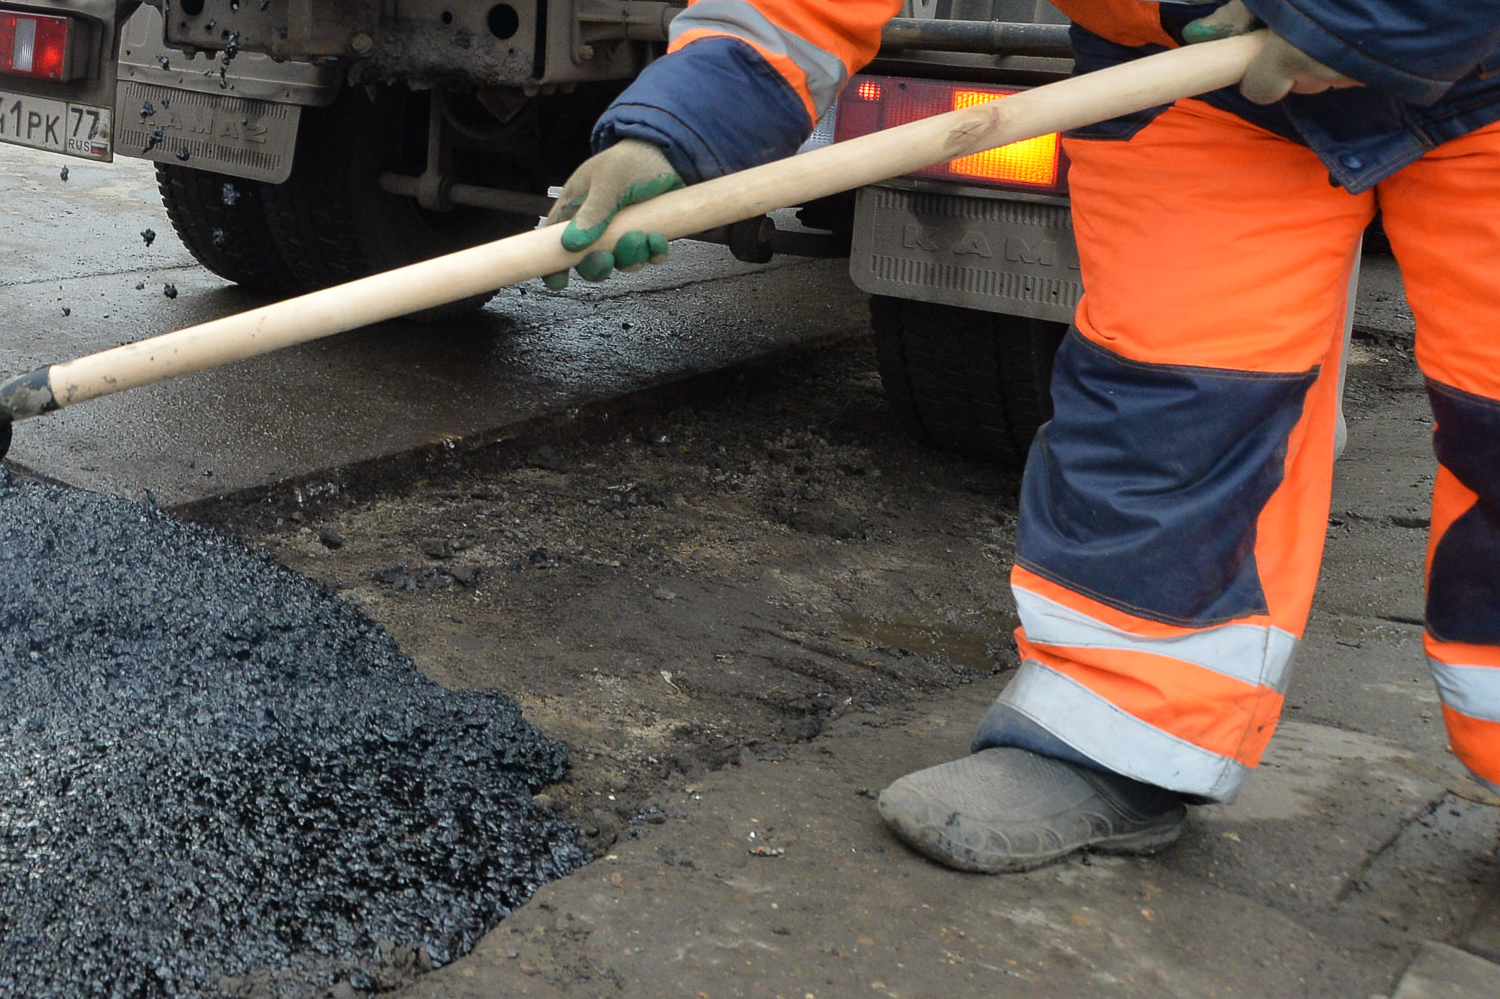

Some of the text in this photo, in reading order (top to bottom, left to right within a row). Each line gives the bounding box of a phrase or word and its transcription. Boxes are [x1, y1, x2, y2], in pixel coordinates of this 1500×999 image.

[70, 107, 100, 140] 77
[68, 138, 90, 152] RUS
[902, 224, 1081, 270] KAM
